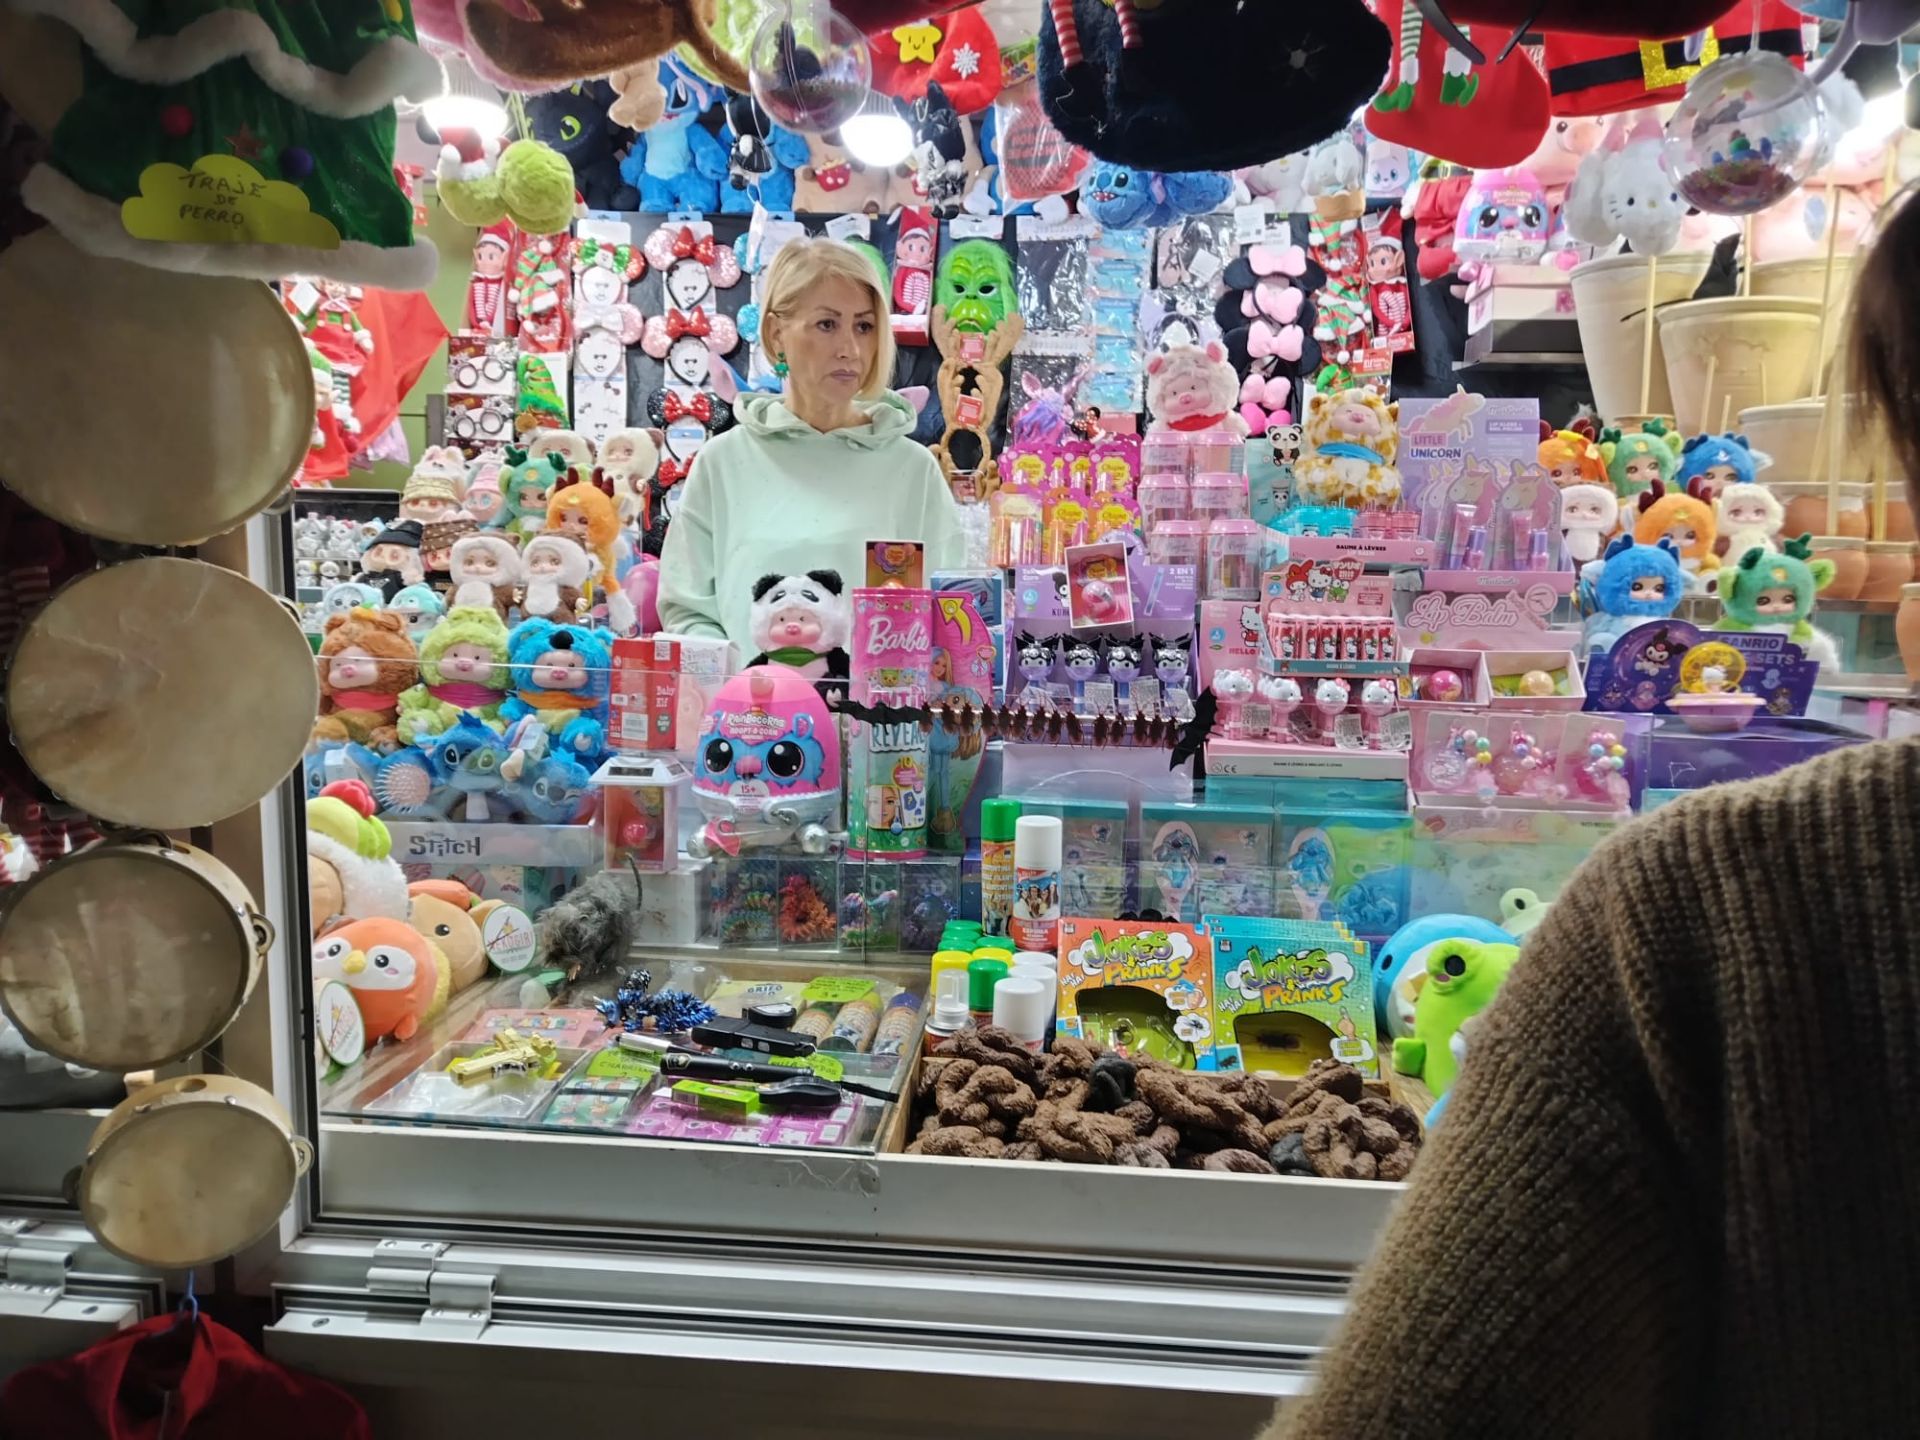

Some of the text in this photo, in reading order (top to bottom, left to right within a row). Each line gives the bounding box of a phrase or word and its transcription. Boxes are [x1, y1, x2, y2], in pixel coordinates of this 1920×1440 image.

[213, 194, 236, 206] DE
[179, 203, 245, 225] PERRO
[1414, 435, 1443, 446] LITTLE
[1169, 567, 1175, 575] 2
[1177, 567, 1188, 575] EN
[1409, 593, 1448, 629] Lip
[1451, 596, 1516, 625] Balm
[867, 615, 930, 655] Barbie
[1755, 653, 1796, 665] SETS
[656, 685, 676, 697] Baby
[1223, 764, 1238, 774] CE
[741, 784, 757, 793] 15+
[1083, 928, 1174, 968] JOKES
[1126, 955, 1137, 968] &
[1241, 946, 1333, 988] JOKES
[1103, 957, 1188, 986] PRANKS
[1286, 978, 1296, 992] &
[1262, 978, 1347, 1009] PRANKS
